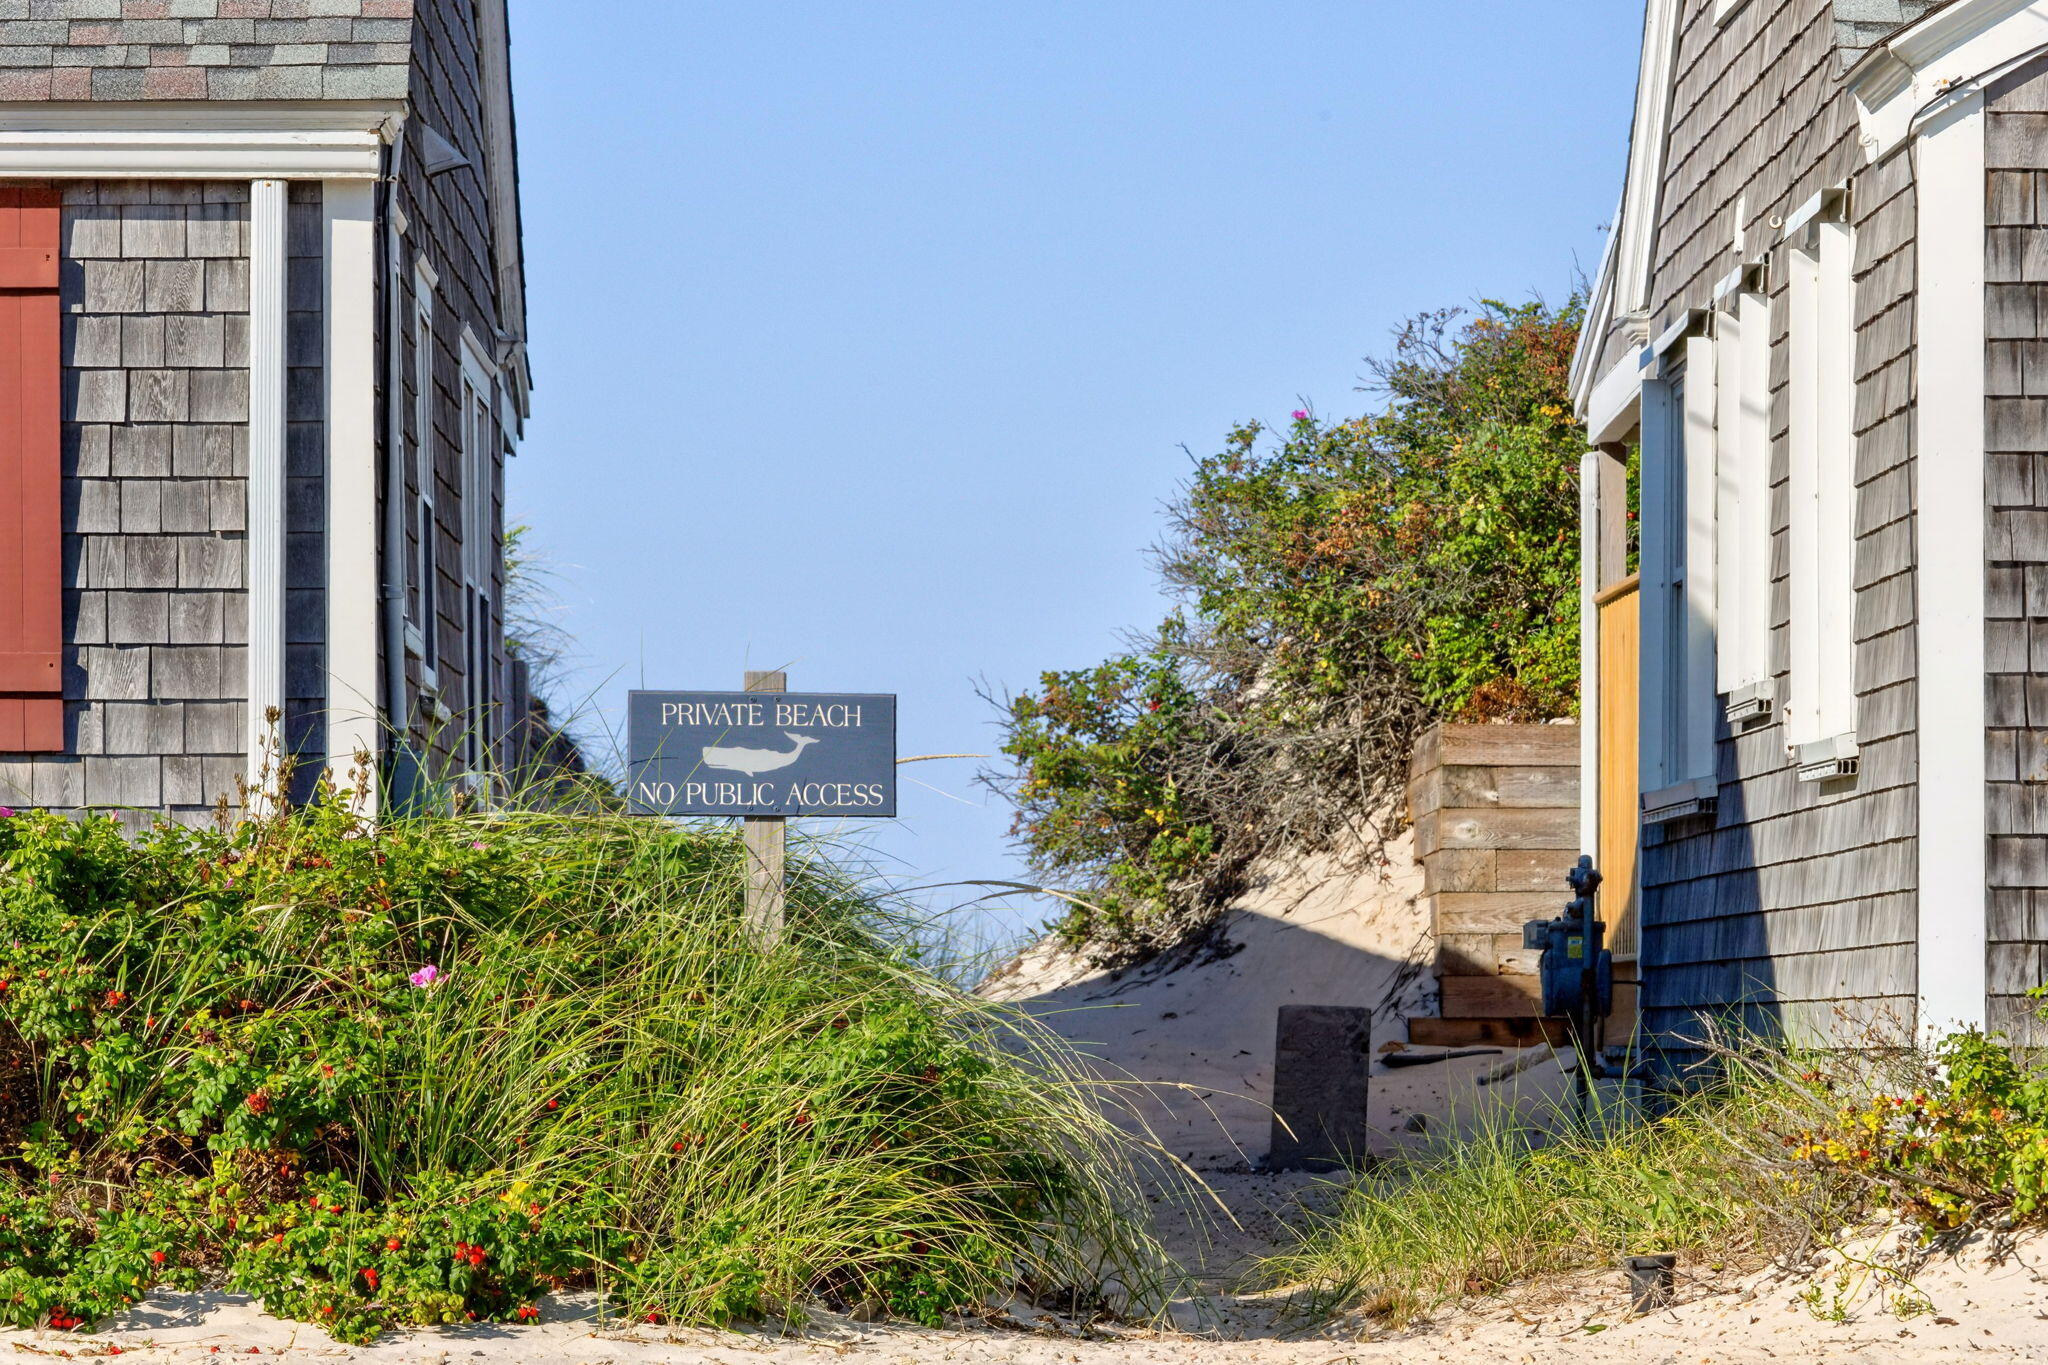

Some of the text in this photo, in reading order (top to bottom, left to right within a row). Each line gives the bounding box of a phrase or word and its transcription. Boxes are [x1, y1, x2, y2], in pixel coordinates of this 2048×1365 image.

[662, 703, 862, 727] PRIVATE BEACH
[639, 782, 884, 807] NO PUBLIC ACCESS
